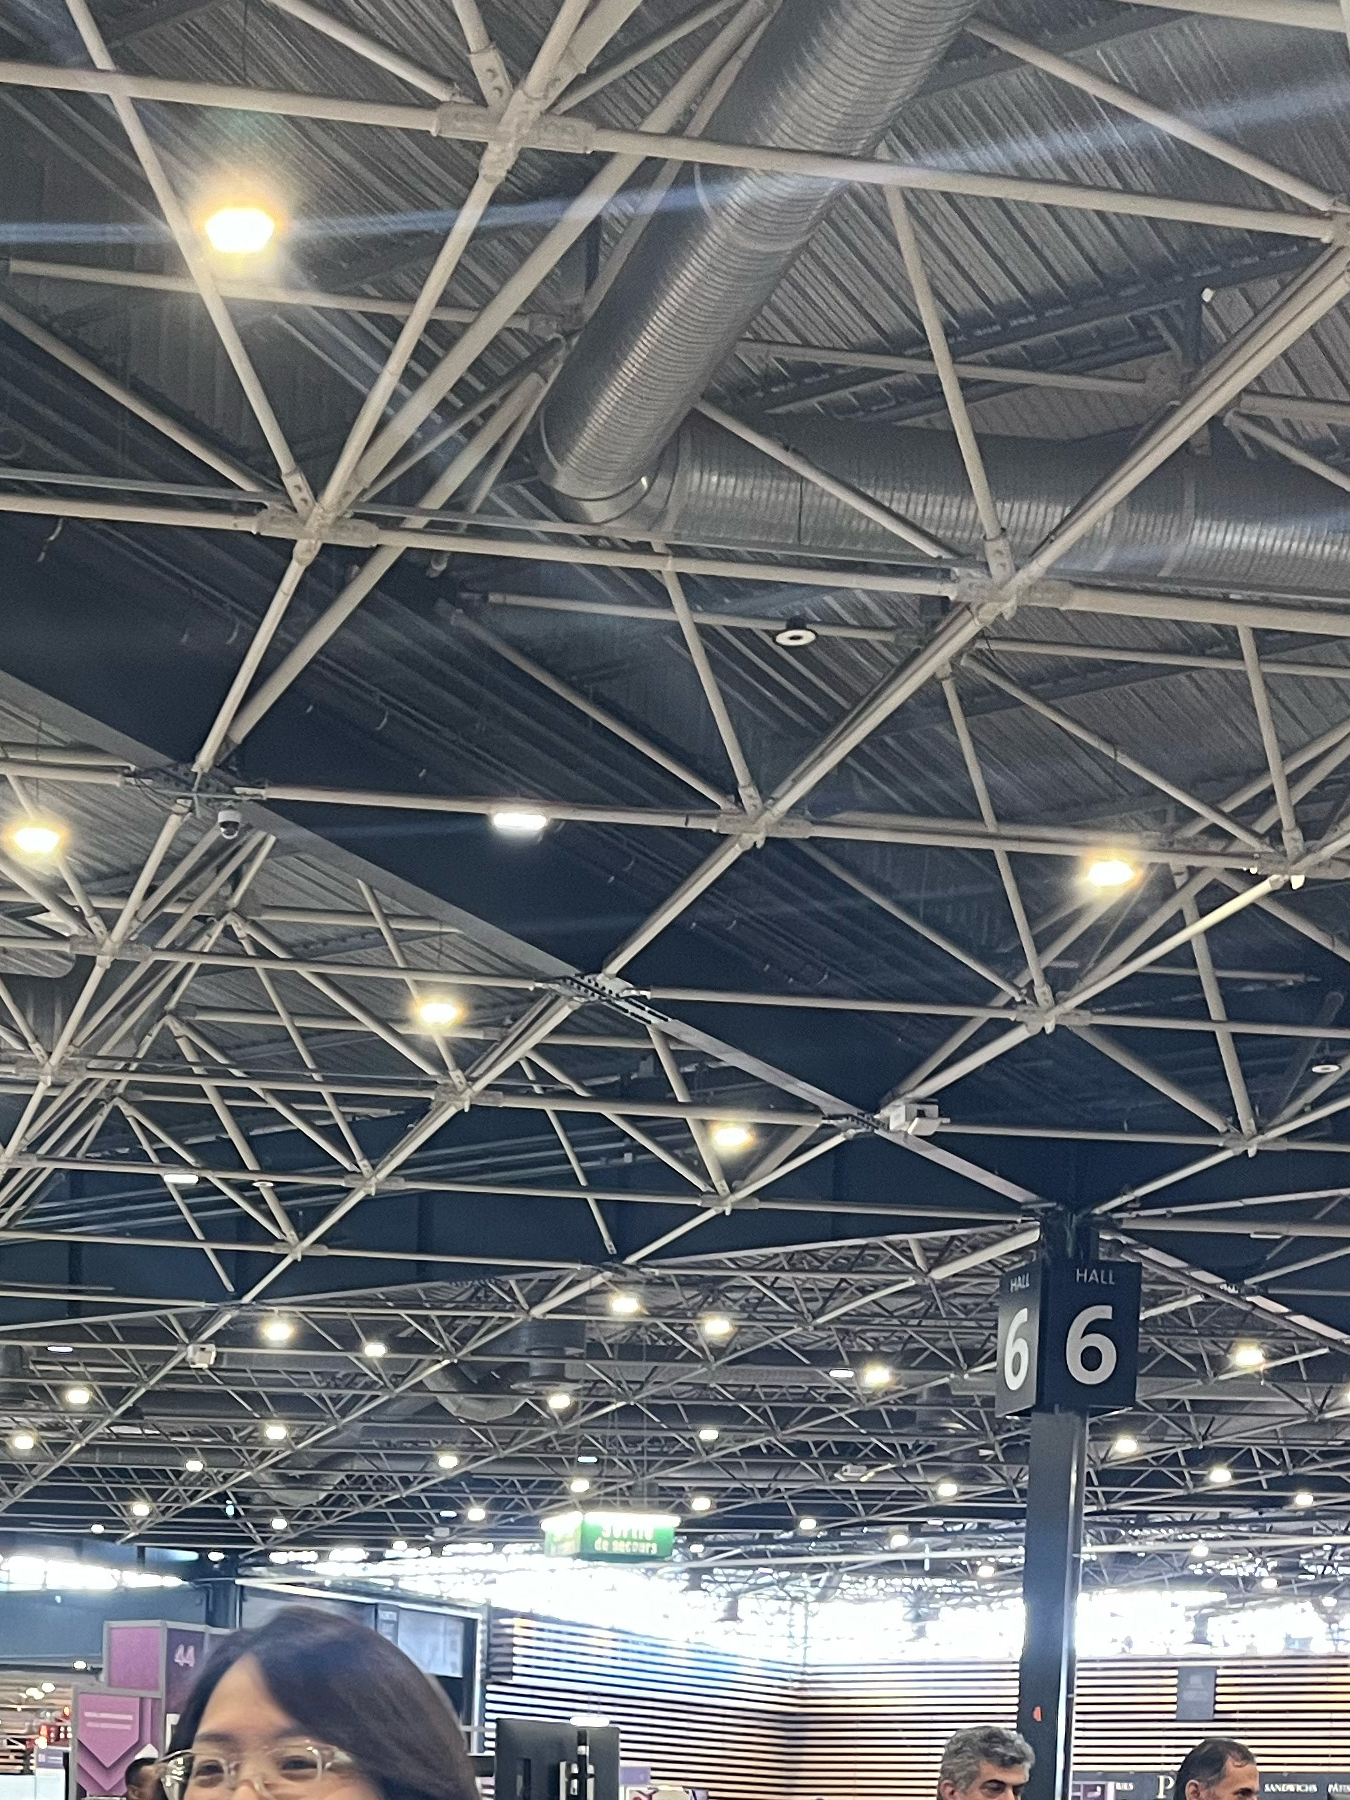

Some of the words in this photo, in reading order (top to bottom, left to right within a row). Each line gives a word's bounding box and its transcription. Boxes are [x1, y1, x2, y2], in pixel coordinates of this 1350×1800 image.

[1010, 1273, 1031, 1293] HALL
[1076, 1268, 1116, 1285] HALL
[1004, 1307, 1030, 1391] 6
[1066, 1304, 1117, 1386] 6
[174, 1644, 195, 1667] 44
